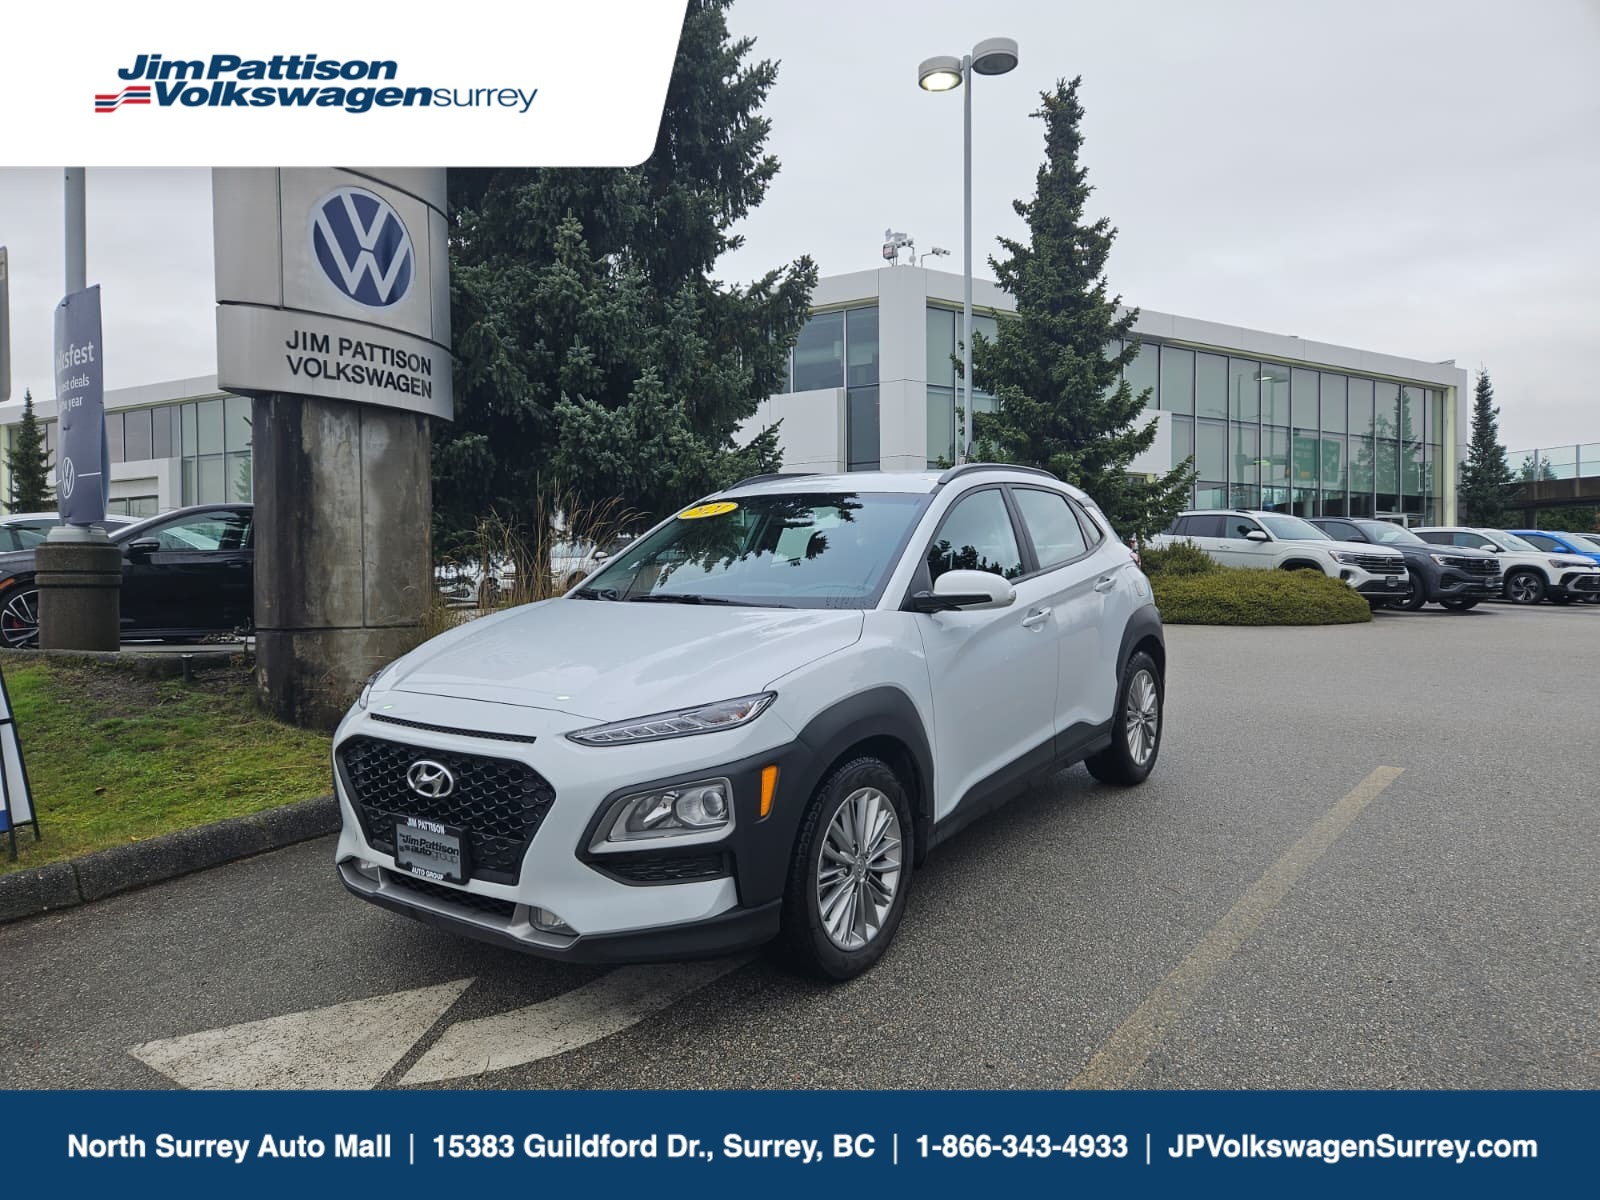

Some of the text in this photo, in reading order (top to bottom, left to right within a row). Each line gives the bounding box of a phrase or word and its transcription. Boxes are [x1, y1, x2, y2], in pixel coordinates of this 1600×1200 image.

[286, 330, 431, 376] JIM PATTISON
[70, 373, 90, 390] deals
[286, 354, 432, 399] VOLKSWAGEN
[68, 396, 83, 412] year
[407, 817, 445, 835] JIM PATTISON
[402, 834, 459, 857] Jim Pattison
[411, 866, 425, 876] AUTO
